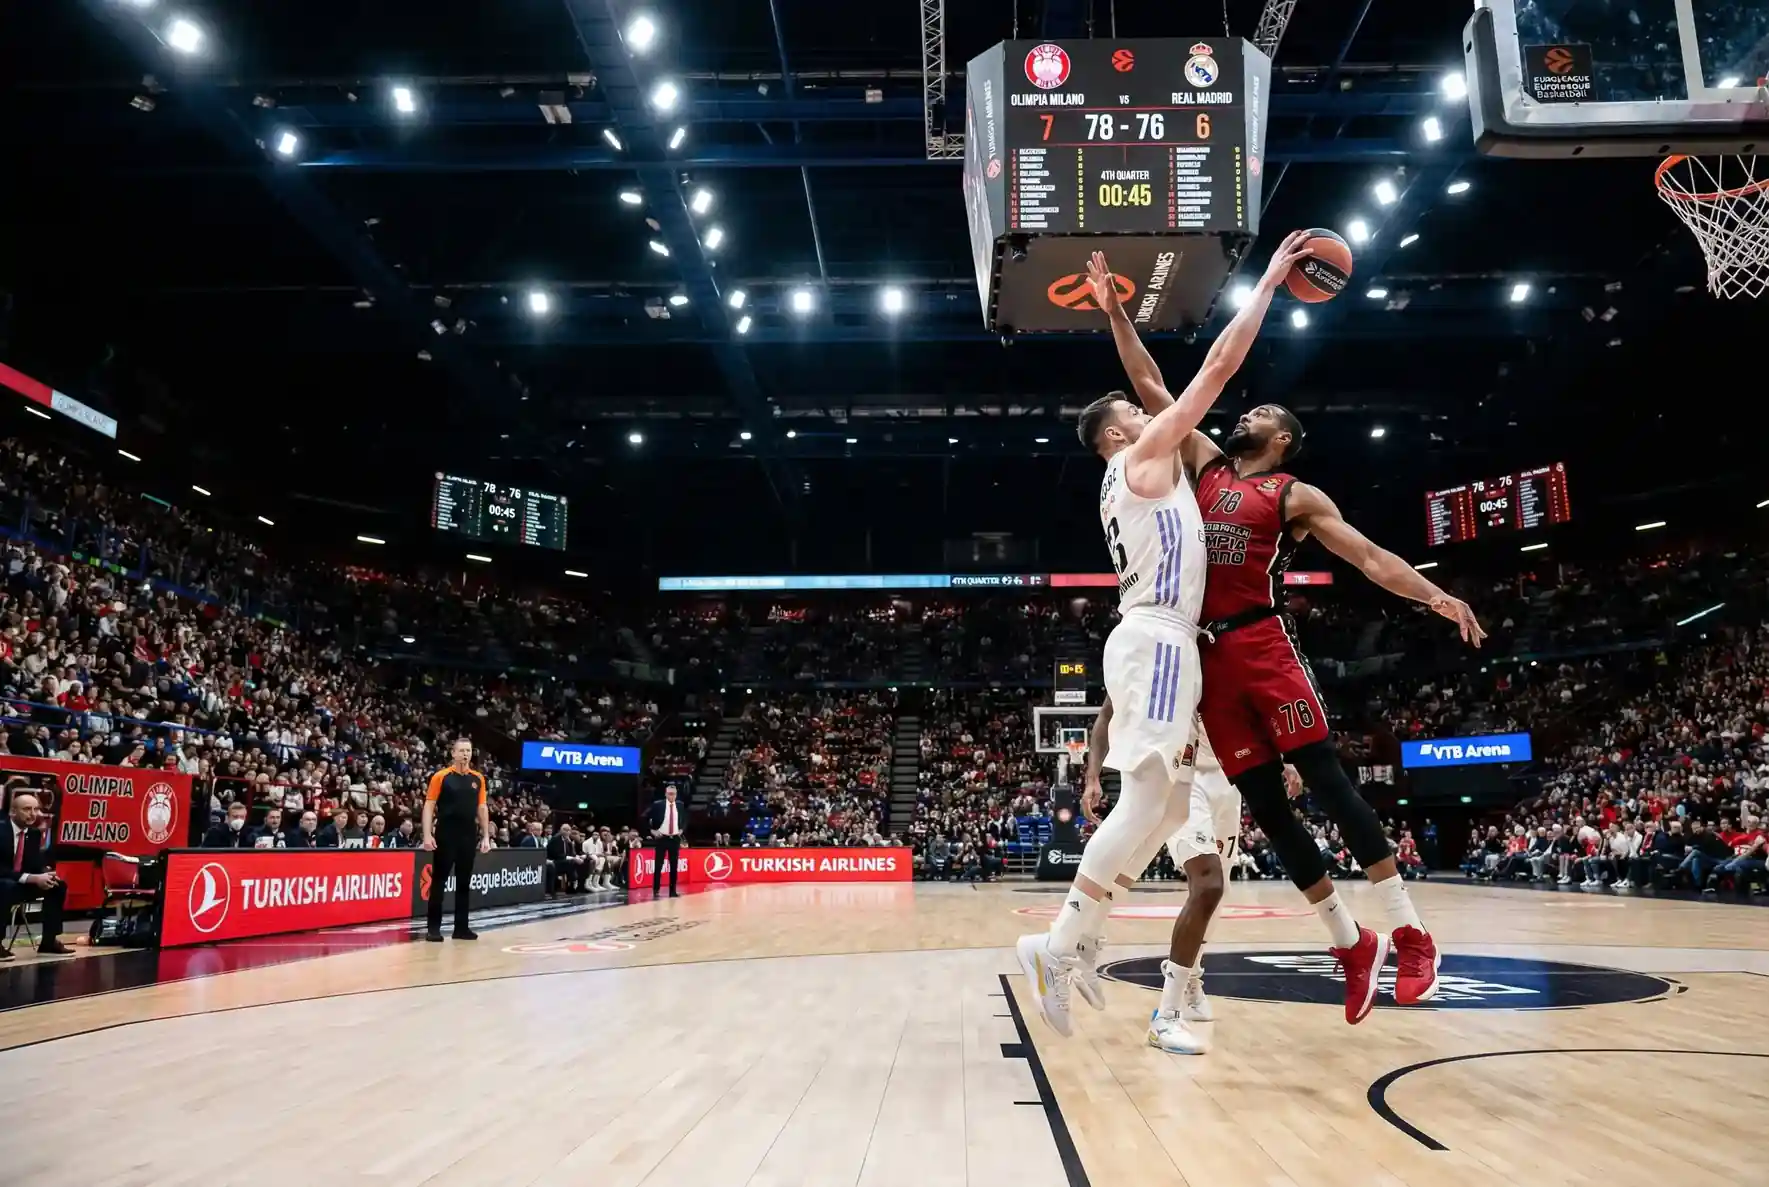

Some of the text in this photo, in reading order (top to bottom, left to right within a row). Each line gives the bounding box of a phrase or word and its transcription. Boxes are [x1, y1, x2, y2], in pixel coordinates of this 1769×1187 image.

[1010, 93, 1085, 106] OLIMPIA MILANO
[1171, 91, 1233, 105] REAL MADRID
[1039, 114, 1054, 141] 7
[1084, 113, 1114, 141] 78
[1135, 113, 1164, 140] 76
[1196, 113, 1210, 139] 6
[1101, 170, 1150, 180] 4TH QUARTER
[1099, 184, 1152, 207] 00:45
[483, 482, 496, 494] 78
[509, 487, 521, 499] 76
[488, 504, 516, 519] 00:45
[1480, 497, 1508, 513] 00:45
[554, 749, 624, 767] VTB Arena
[1432, 744, 1506, 759] VTB Arena
[65, 773, 134, 798] OLIMPIA
[88, 799, 108, 820] DI
[61, 821, 130, 843] MILANO
[740, 857, 897, 873] TURKISH AIRLINES
[501, 865, 543, 887] Basketball
[241, 872, 403, 910] TURKISH AIRLINES
